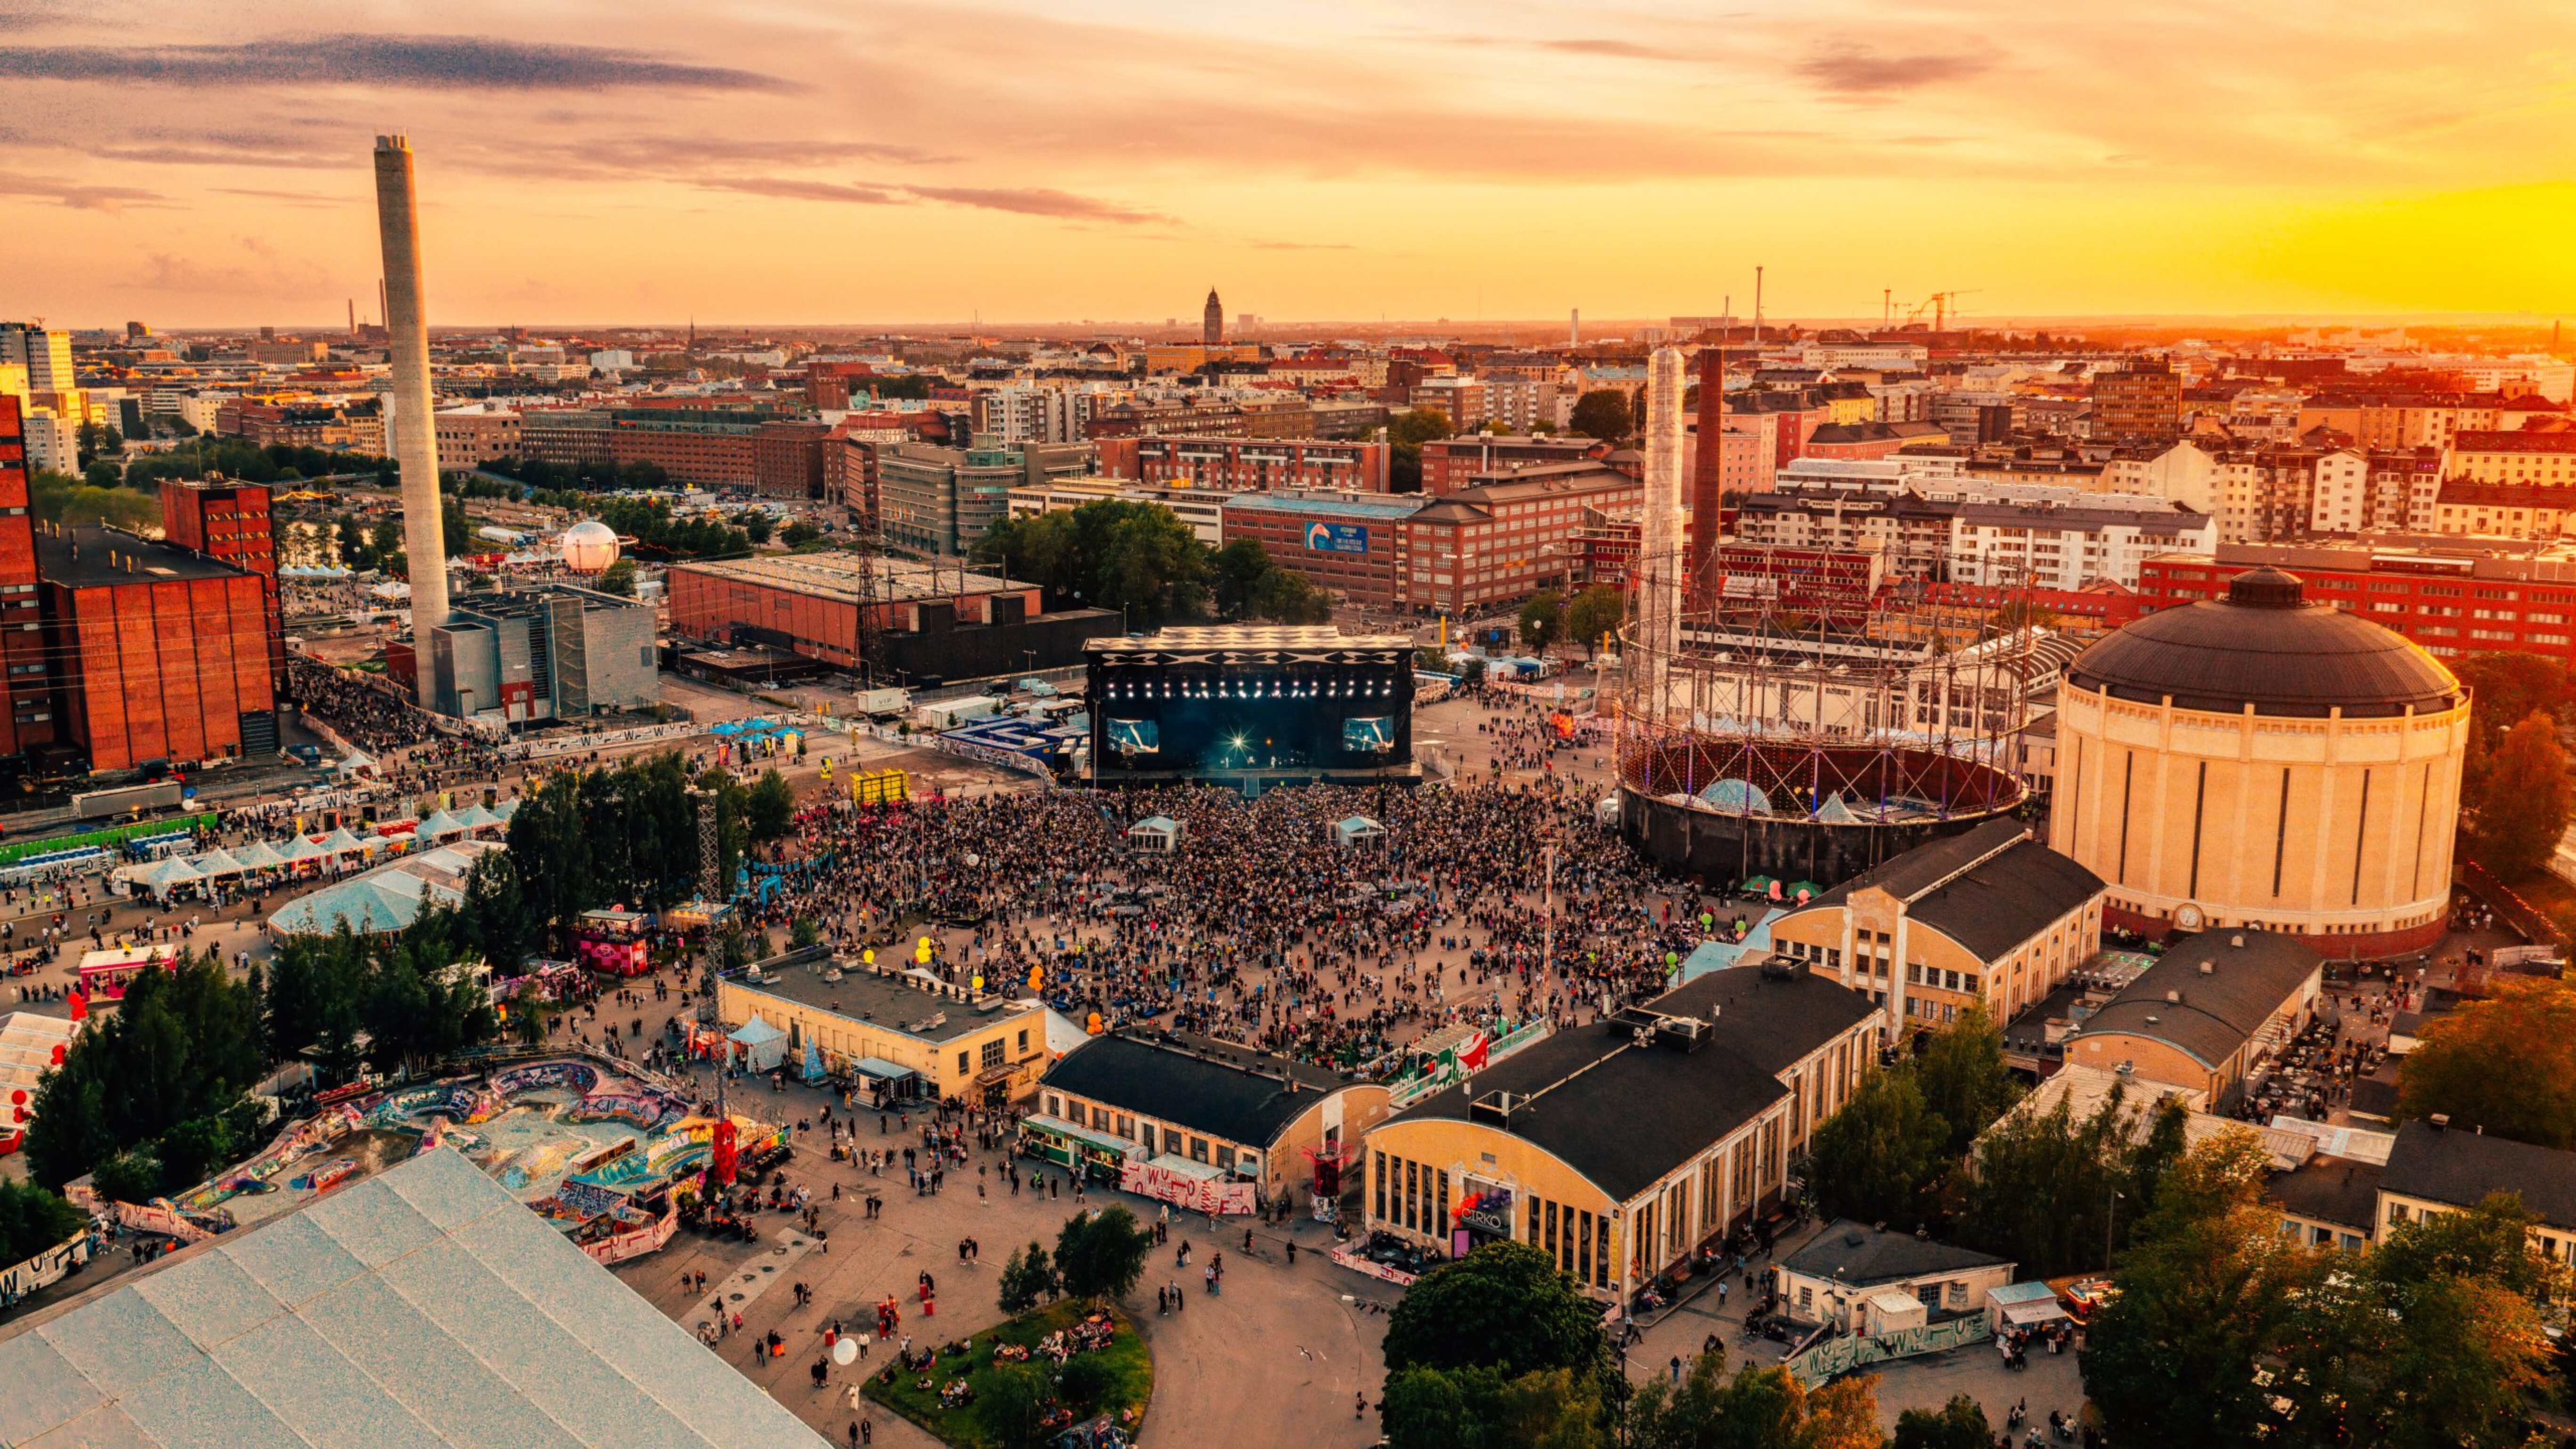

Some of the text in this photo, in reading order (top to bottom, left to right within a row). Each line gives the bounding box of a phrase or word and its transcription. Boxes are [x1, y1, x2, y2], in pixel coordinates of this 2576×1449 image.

[1148, 1167, 1159, 1186] W
[1187, 1179, 1195, 1196] O
[1462, 1208, 1501, 1228] CIRKO
[1892, 1333, 1906, 1352] W
[1809, 1351, 1820, 1371] W
